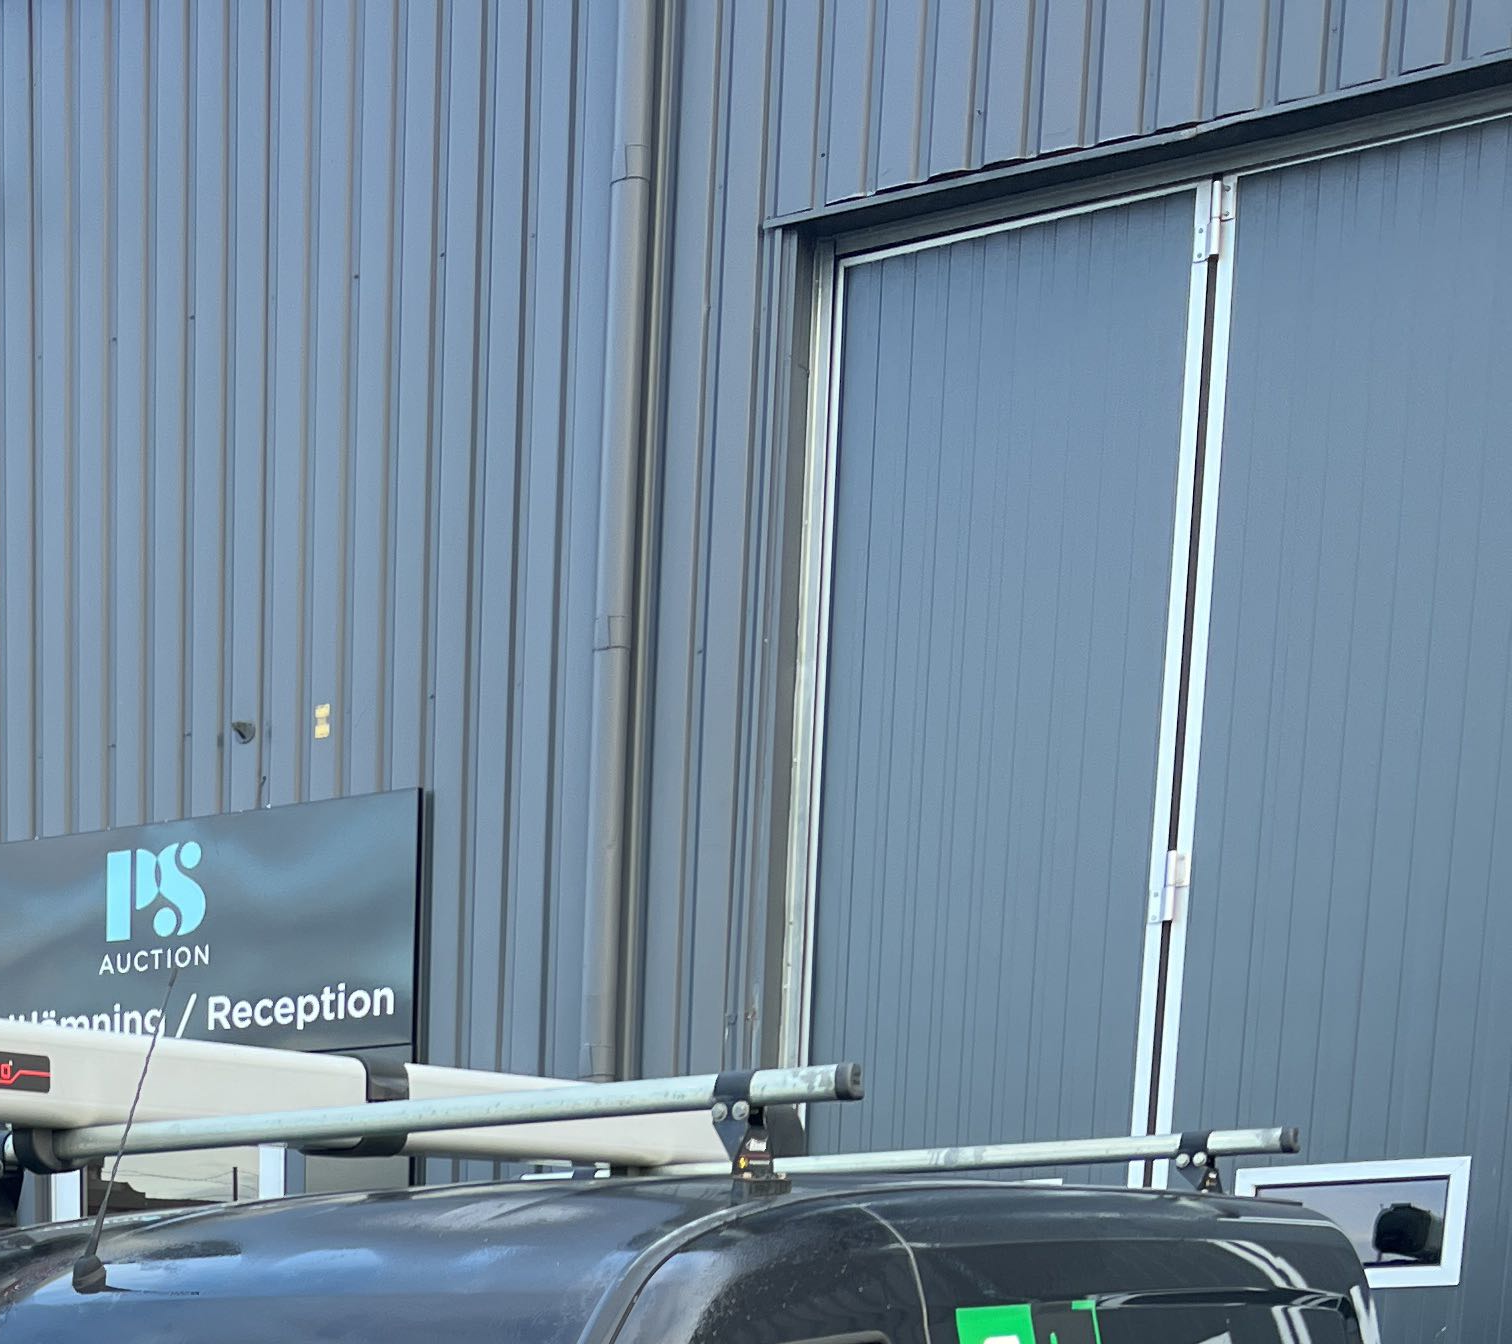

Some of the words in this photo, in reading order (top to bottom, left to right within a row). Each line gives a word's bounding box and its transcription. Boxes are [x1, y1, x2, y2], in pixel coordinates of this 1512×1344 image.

[106, 841, 207, 942] PS
[99, 944, 210, 976] AUCTION
[207, 983, 395, 1031] Reception
